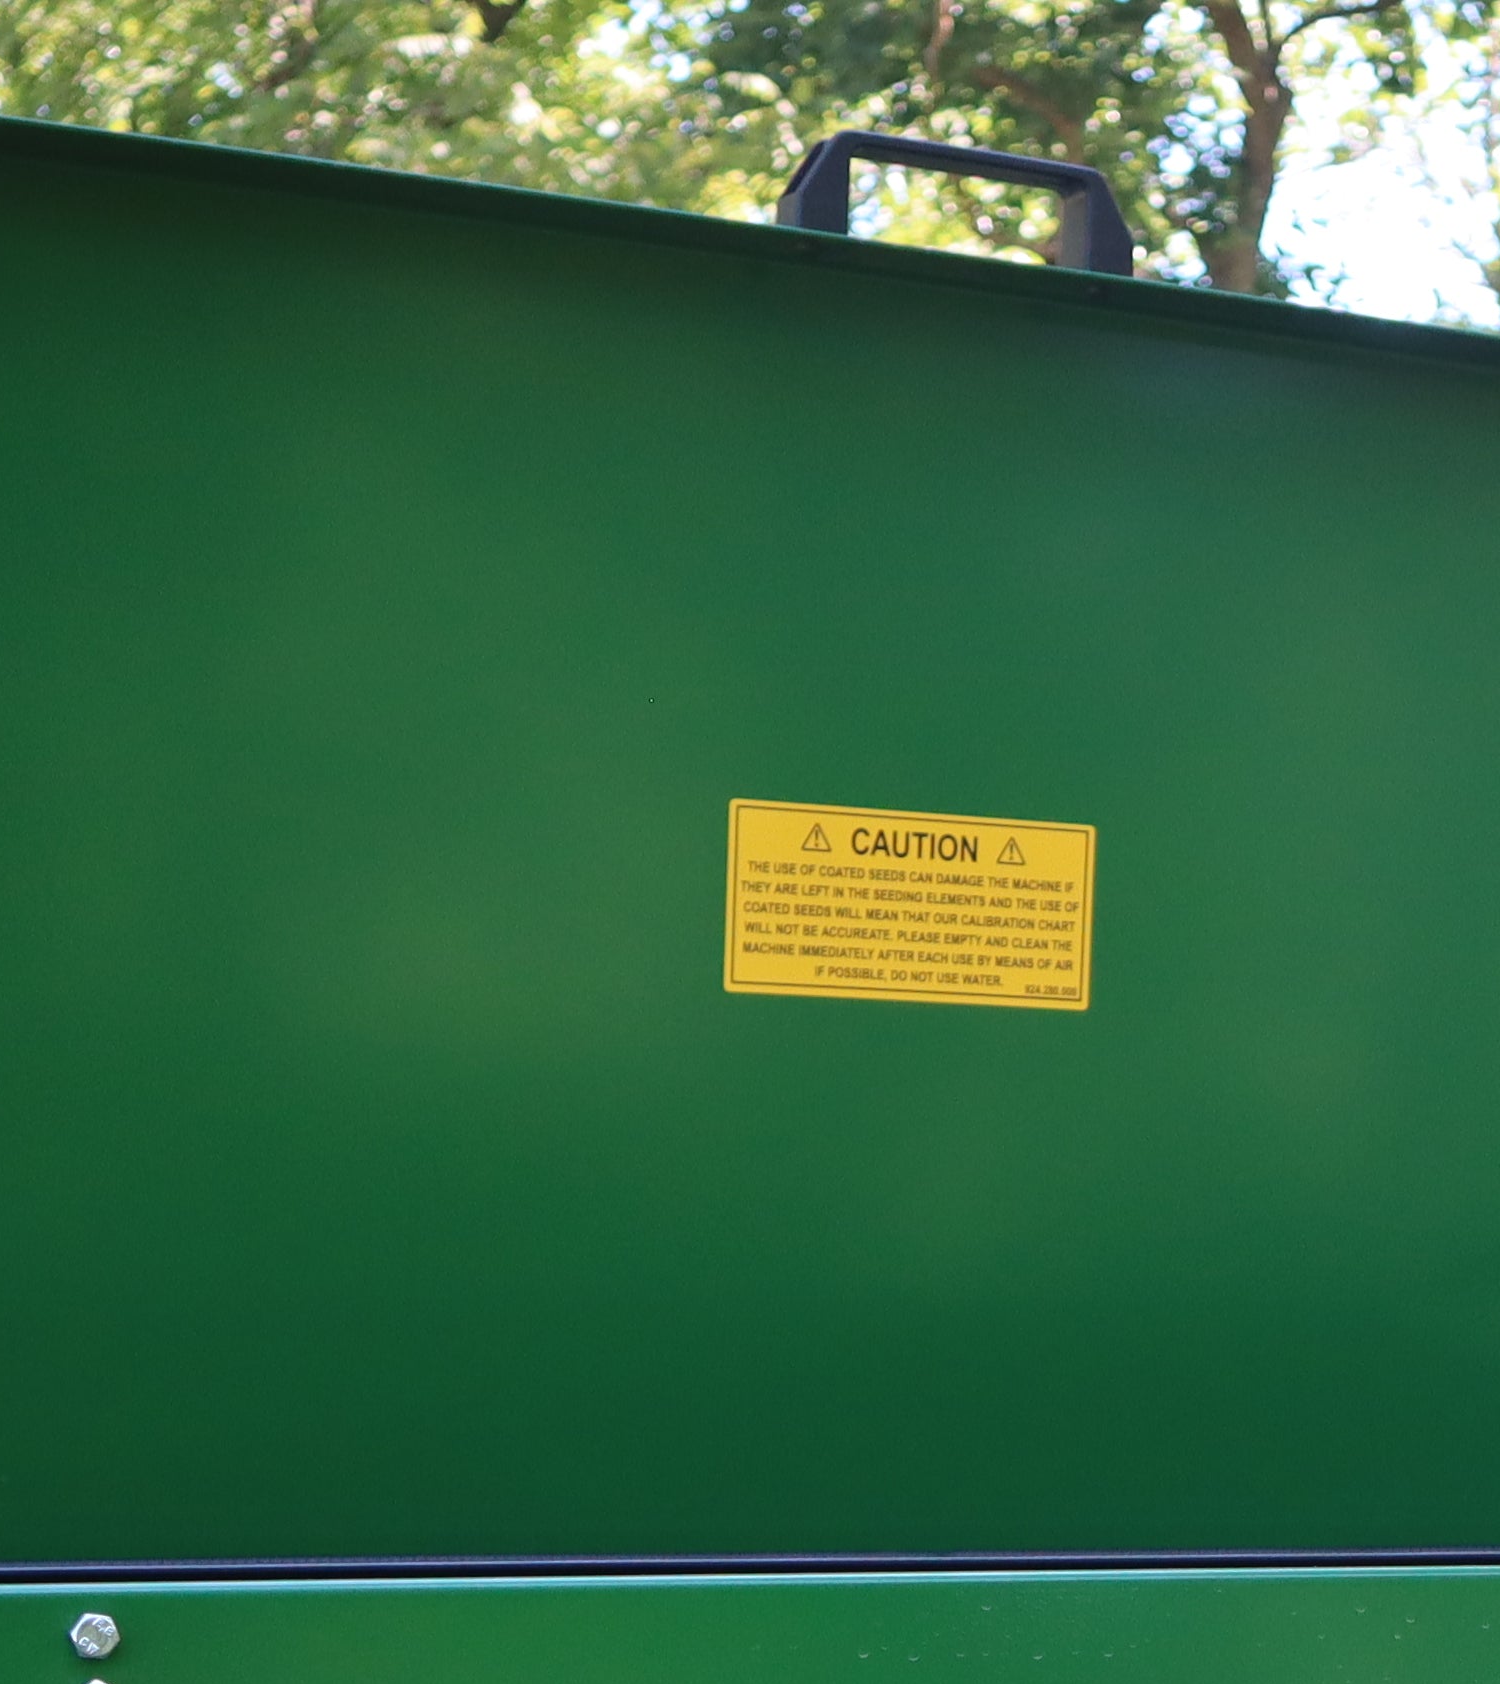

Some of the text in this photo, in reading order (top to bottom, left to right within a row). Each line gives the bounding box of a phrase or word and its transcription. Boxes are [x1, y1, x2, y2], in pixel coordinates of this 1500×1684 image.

[851, 827, 978, 862] CAUTION
[748, 859, 1073, 893] THE USE OF COATED SEEDS CAN DAMAGE THE MACHINE IF
[740, 879, 771, 893] THEY
[774, 881, 798, 895] ARE
[800, 883, 829, 898] LEFT
[831, 885, 845, 898] IN
[848, 886, 870, 900] THE
[925, 891, 986, 907] ELEMENTS
[988, 896, 1013, 909] AND
[1015, 897, 1037, 911] THE
[1039, 898, 1062, 912] USE
[1064, 900, 1081, 914] OF
[743, 900, 1075, 932] COATED SEEDS WILL MEAN THAT OUR CALIBRATION CHART
[744, 920, 771, 935] WILL
[774, 922, 799, 936] NOT
[801, 923, 819, 937] BE
[896, 929, 941, 944] PLEASE
[943, 932, 982, 946] EMPTY
[985, 935, 1009, 948] AND
[1011, 936, 1049, 951] CLEAN
[1052, 938, 1073, 952] THE
[741, 940, 1073, 971] MACHINE IMMEDIATELY AFTER EACH USE BY MEANS OF AIR
[813, 964, 825, 977] IF
[889, 968, 908, 982] DO
[909, 969, 933, 983] NOT
[936, 971, 959, 984] USE
